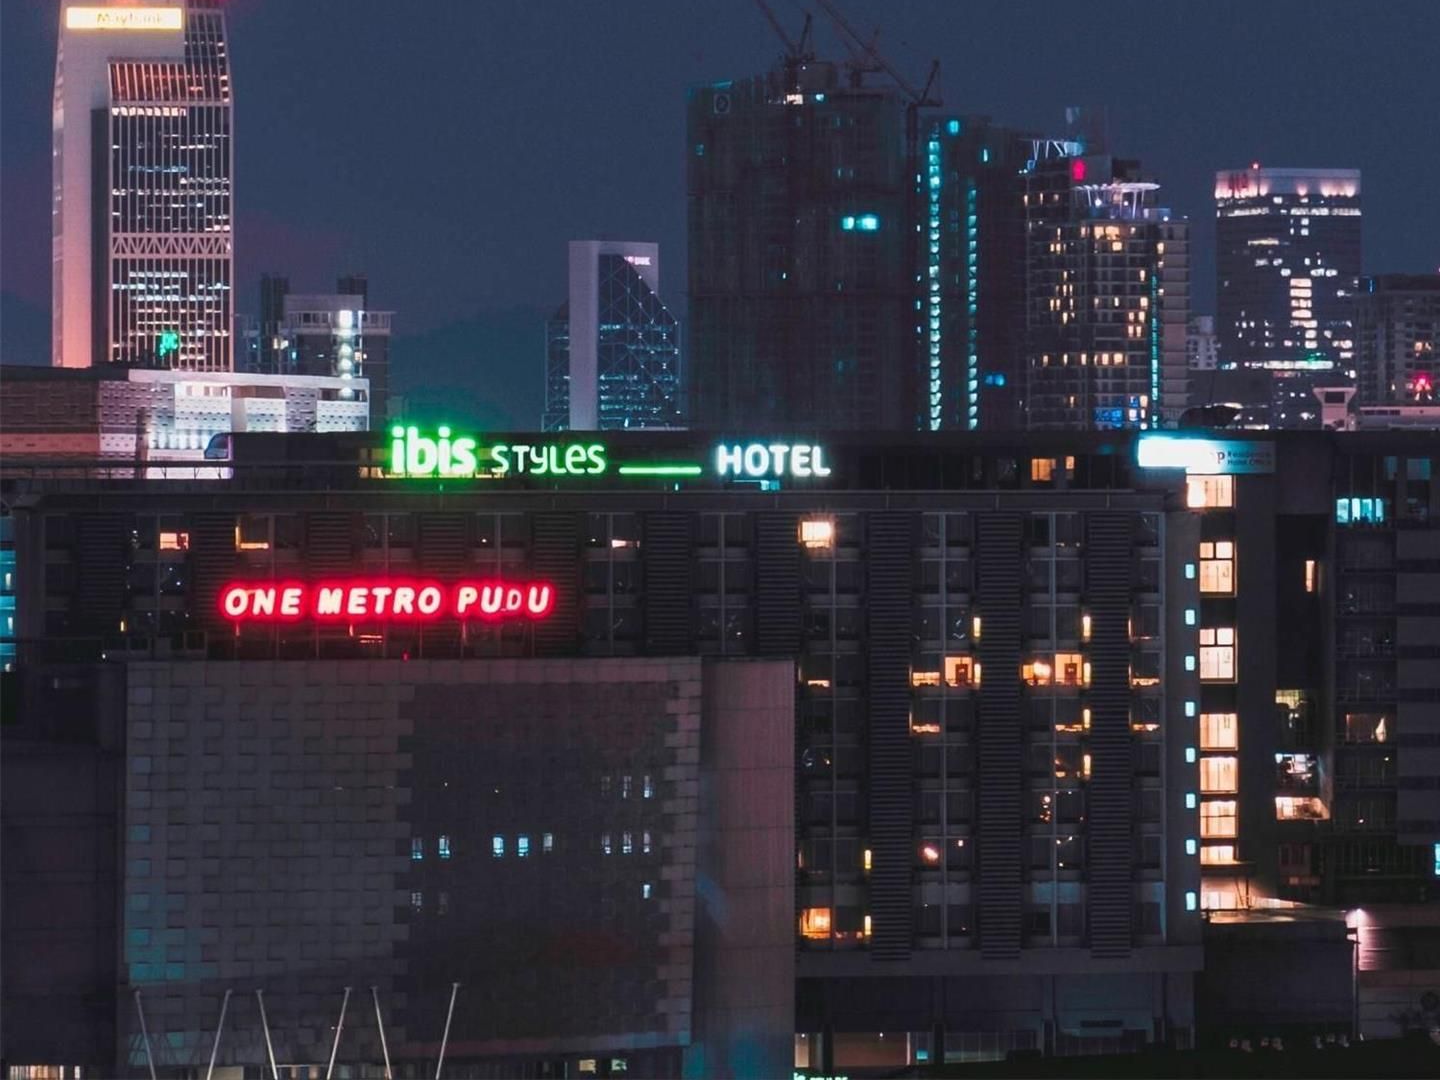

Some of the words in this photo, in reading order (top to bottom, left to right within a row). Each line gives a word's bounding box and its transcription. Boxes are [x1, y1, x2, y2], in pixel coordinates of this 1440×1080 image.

[390, 425, 477, 476] ibis
[716, 443, 832, 477] HOTEL
[224, 587, 303, 616] ONE
[317, 586, 442, 615] METRO
[456, 585, 550, 614] PUDU
